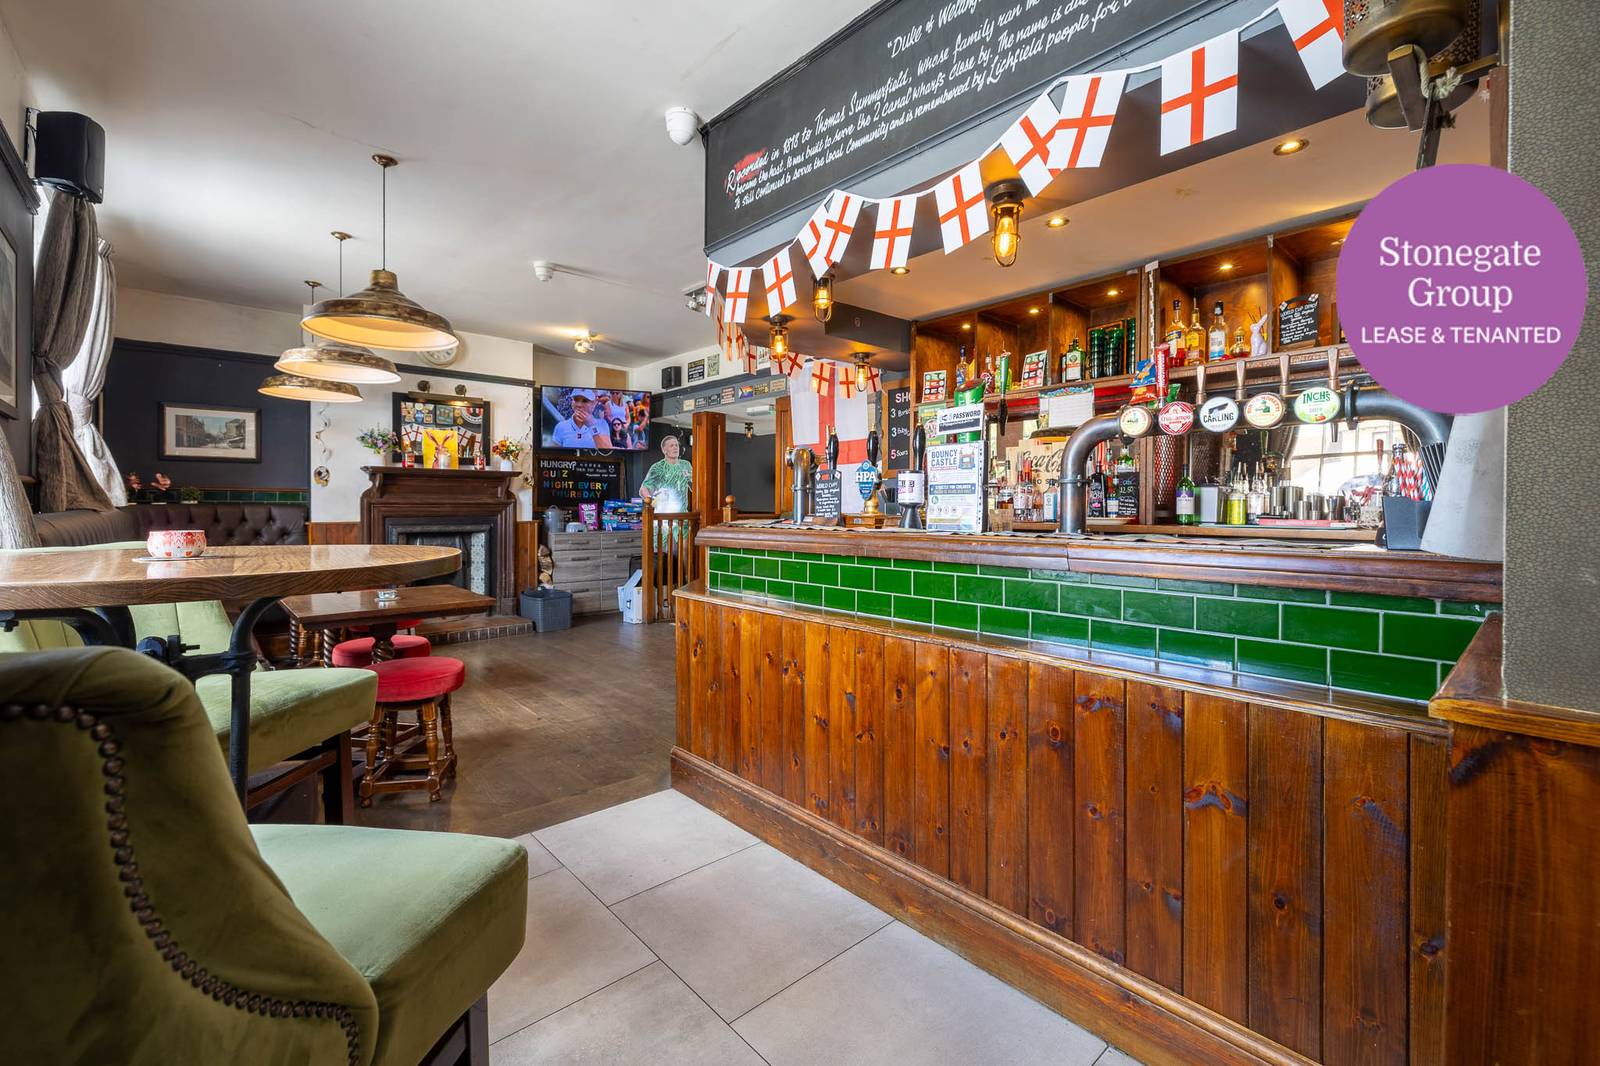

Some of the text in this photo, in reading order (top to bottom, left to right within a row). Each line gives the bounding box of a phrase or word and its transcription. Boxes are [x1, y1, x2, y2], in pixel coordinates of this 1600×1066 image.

[925, 13, 935, 34] of
[938, 0, 982, 28] Welling
[831, 123, 856, 145] serve
[857, 112, 872, 131] the
[873, 101, 881, 122] 2
[998, 29, 1015, 54] The
[1015, 15, 1049, 44] name
[1050, 5, 1063, 24] is
[770, 148, 780, 161] in
[801, 126, 814, 144] to
[815, 105, 846, 136] Thomas
[917, 47, 950, 77] whose
[952, 17, 996, 65] family
[997, 3, 1023, 28] ran
[813, 156, 825, 170] the
[888, 111, 906, 130] and
[905, 108, 914, 123] is
[914, 75, 972, 118] remembered
[971, 69, 987, 93] by
[986, 33, 1046, 86] Lichfield
[1044, 12, 1090, 54] people
[1090, 0, 1121, 34] for
[890, 408, 897, 418] 3
[952, 409, 981, 420] PASSWORD
[1203, 412, 1234, 423] CARLING
[891, 427, 897, 437] 3
[890, 449, 897, 459] 5
[931, 449, 958, 458] BOUNCY
[540, 460, 577, 471] HUNGRY?
[930, 457, 958, 467] CASTLE
[856, 470, 877, 481] HPA
[543, 480, 608, 490] NIGHT EVERY
